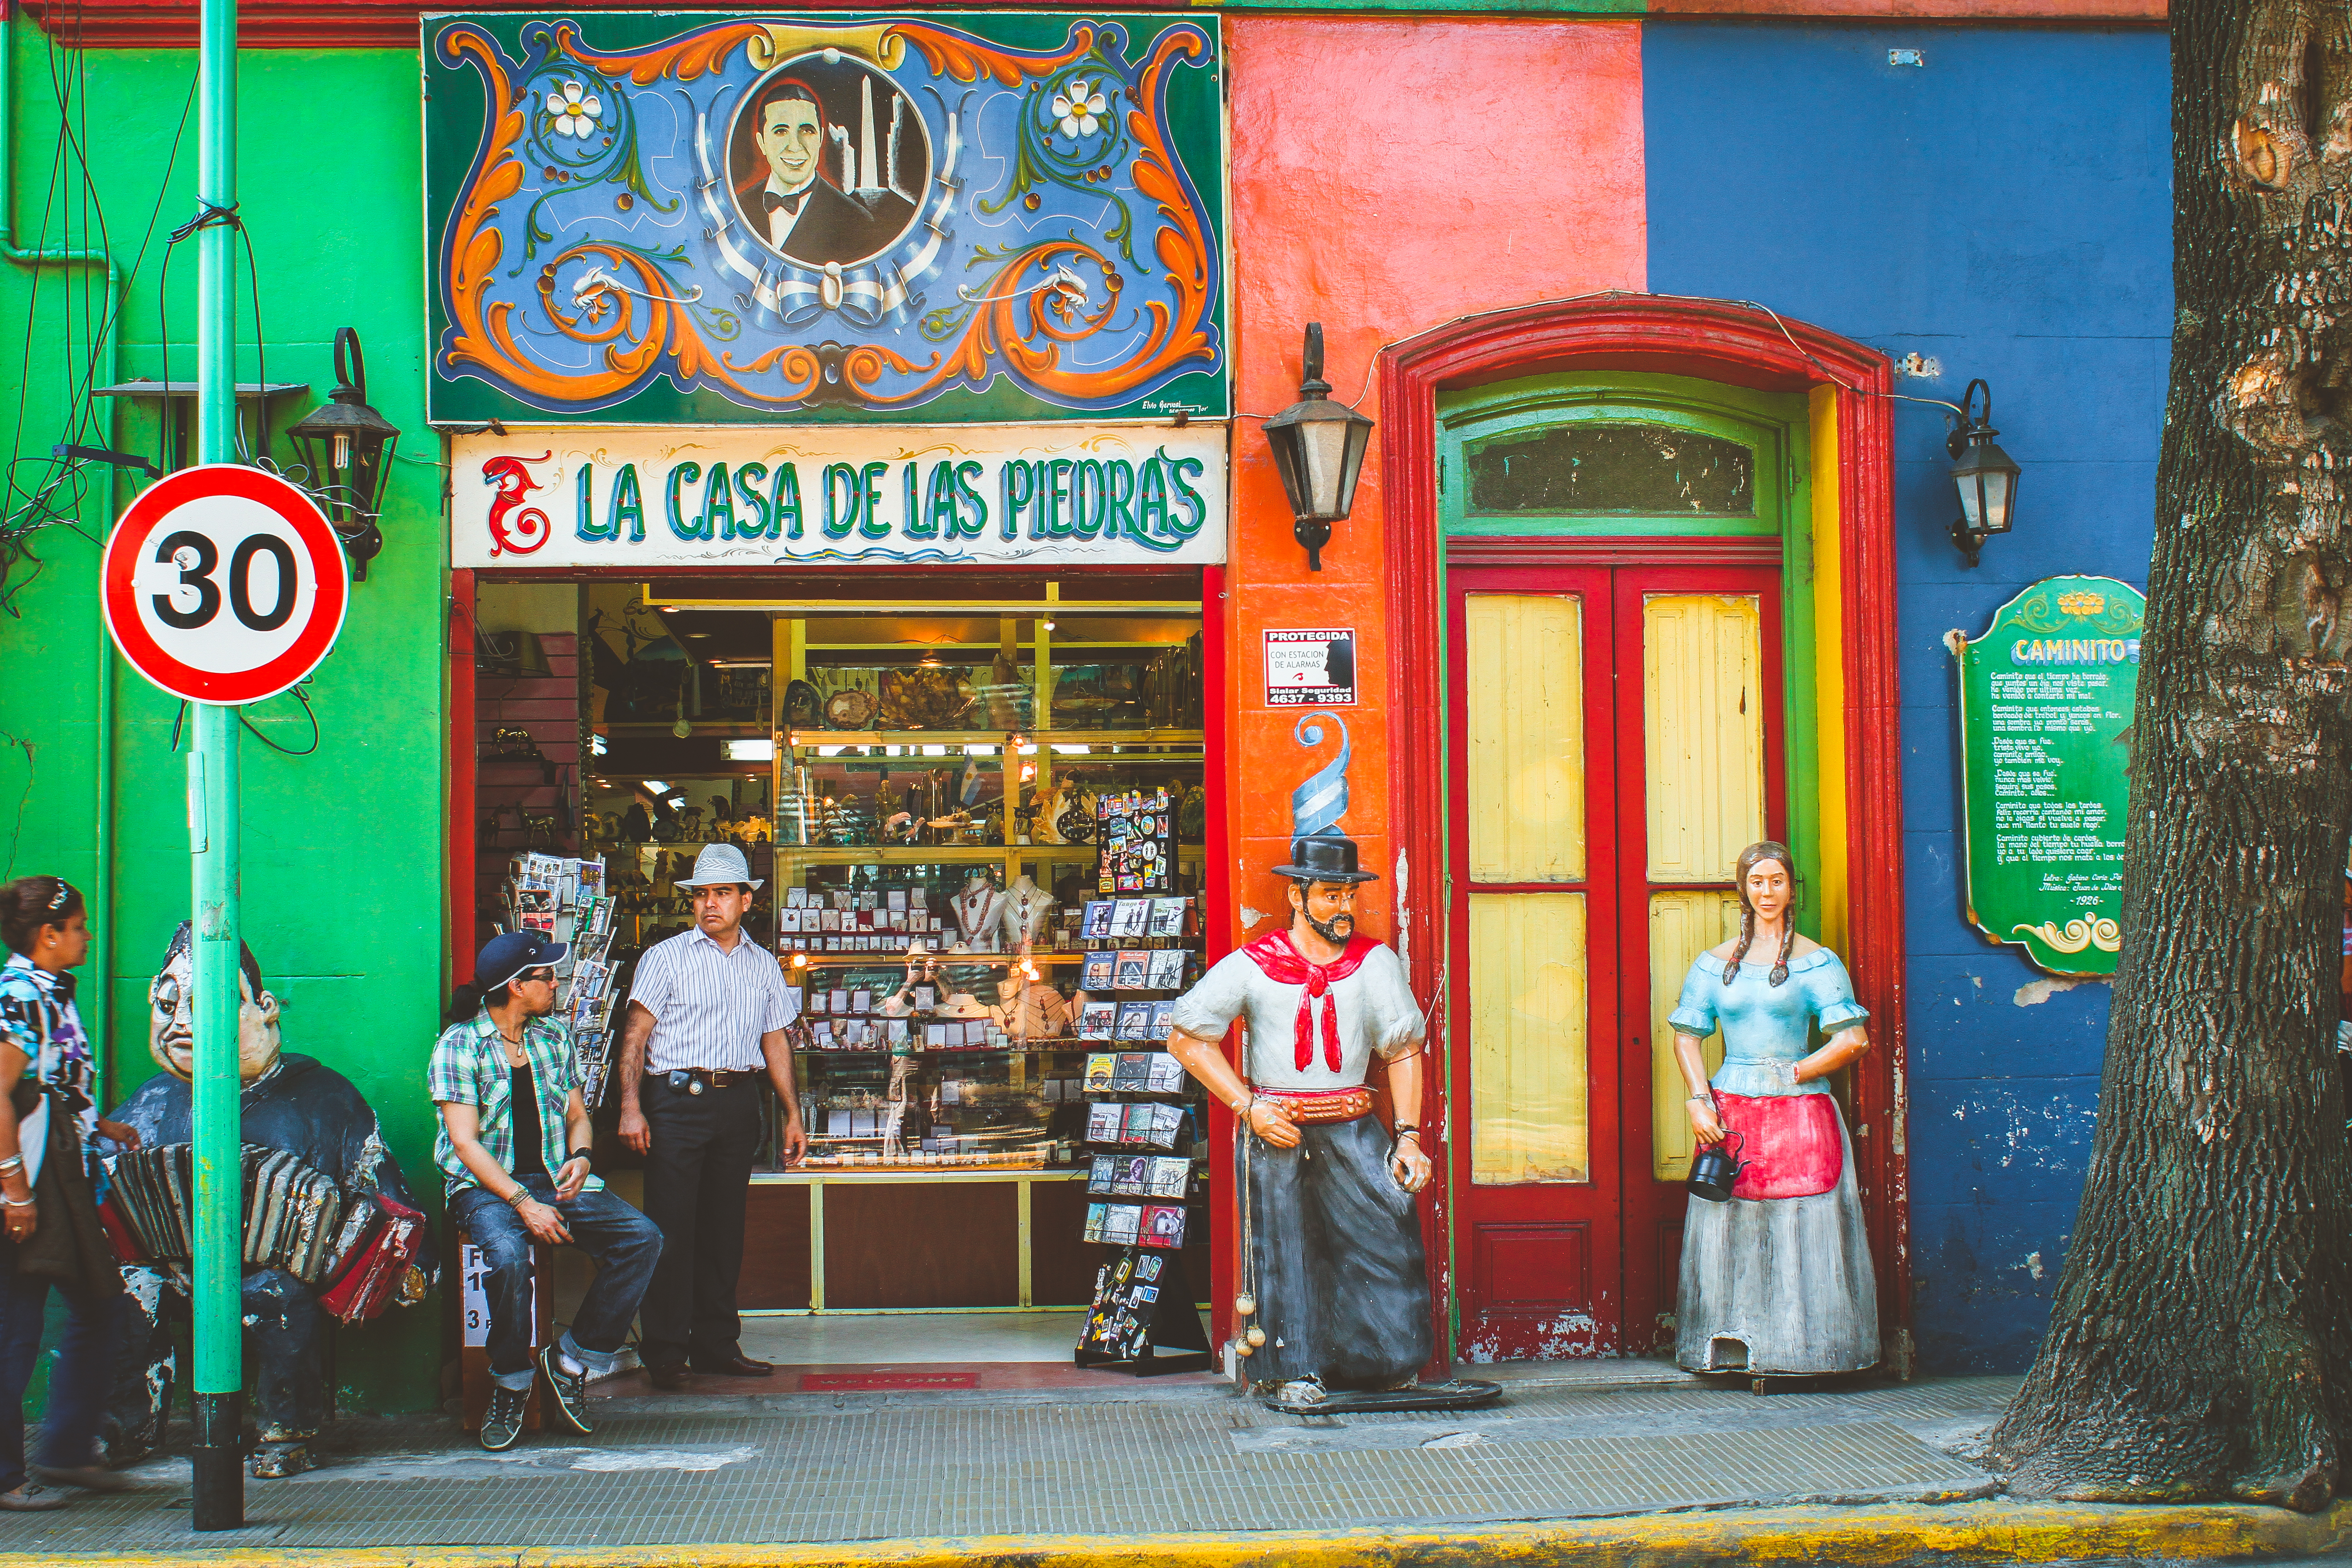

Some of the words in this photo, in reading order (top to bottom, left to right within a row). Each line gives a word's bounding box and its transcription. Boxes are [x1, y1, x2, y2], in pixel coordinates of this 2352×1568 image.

[577, 462, 647, 544] LA
[667, 461, 805, 543] CASA
[822, 462, 892, 543] DE
[903, 461, 985, 541] LAS
[1000, 445, 1209, 551] PIEDRAS
[152, 530, 298, 632] 30
[1269, 632, 1350, 641] PROTEGIDA
[2012, 639, 2126, 665] CAMINITO
[1990, 671, 2023, 680] Caminito
[2046, 672, 2069, 681] tiempo
[1270, 694, 1305, 703] 4637
[1317, 694, 1352, 702] 9393
[1994, 758, 2002, 766] yo
[2042, 841, 2068, 849] tiempo
[2032, 855, 2057, 863] tiempo
[2073, 882, 2090, 891] Juan
